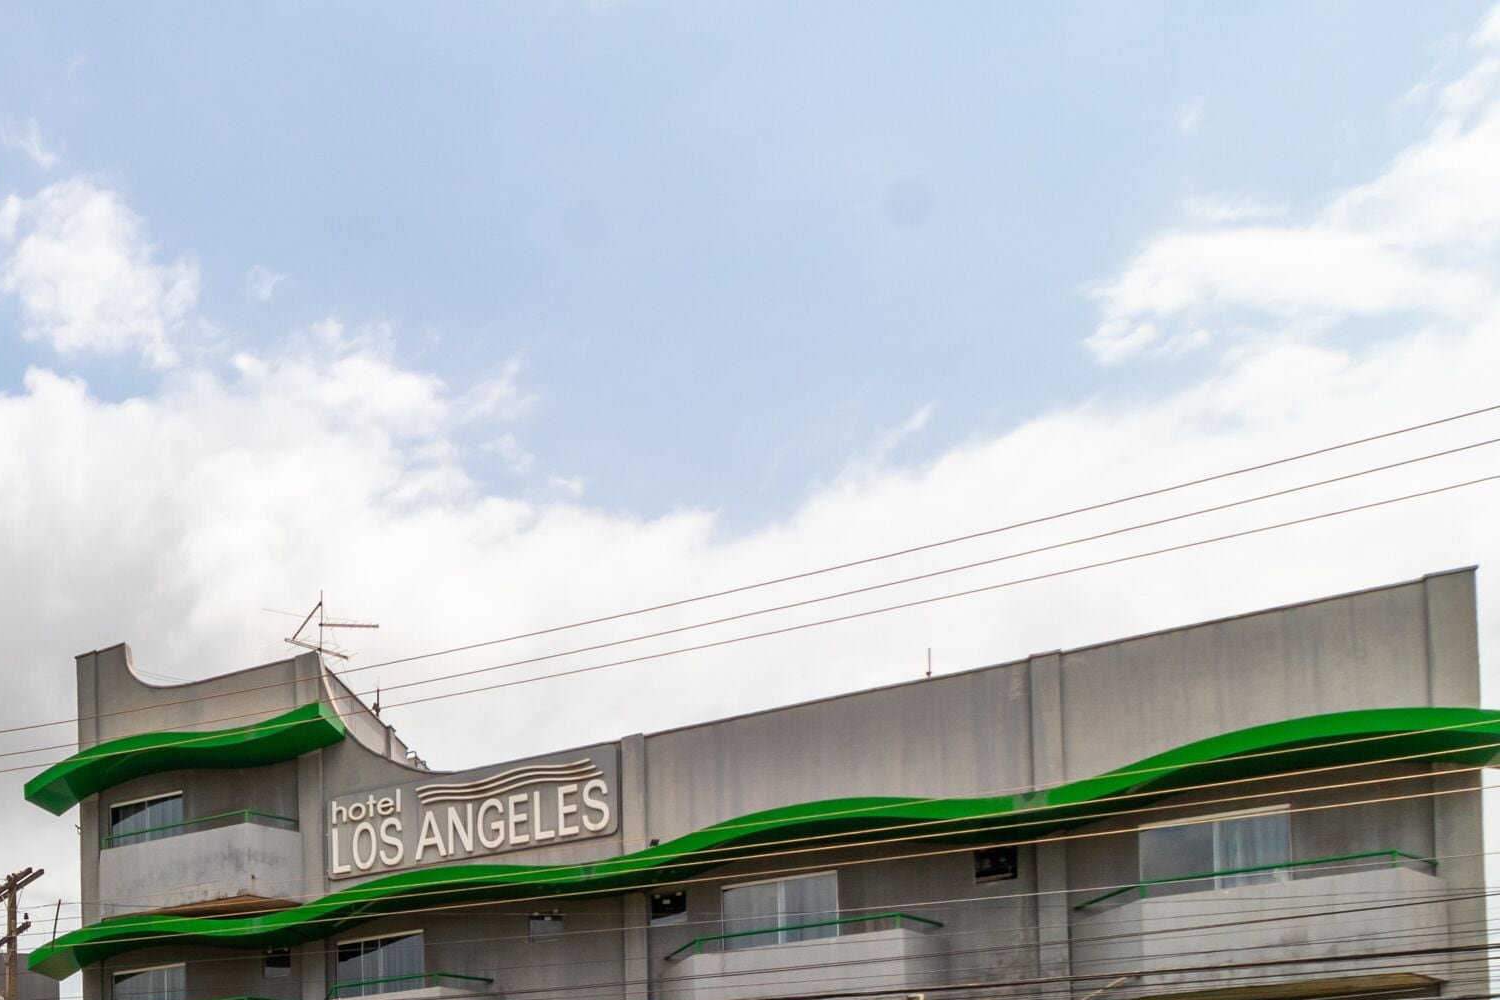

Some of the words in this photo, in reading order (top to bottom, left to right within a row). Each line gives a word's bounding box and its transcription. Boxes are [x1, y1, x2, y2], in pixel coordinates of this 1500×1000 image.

[331, 788, 402, 824] hotel
[331, 817, 404, 875] LOS
[414, 779, 610, 861] ANGELES
